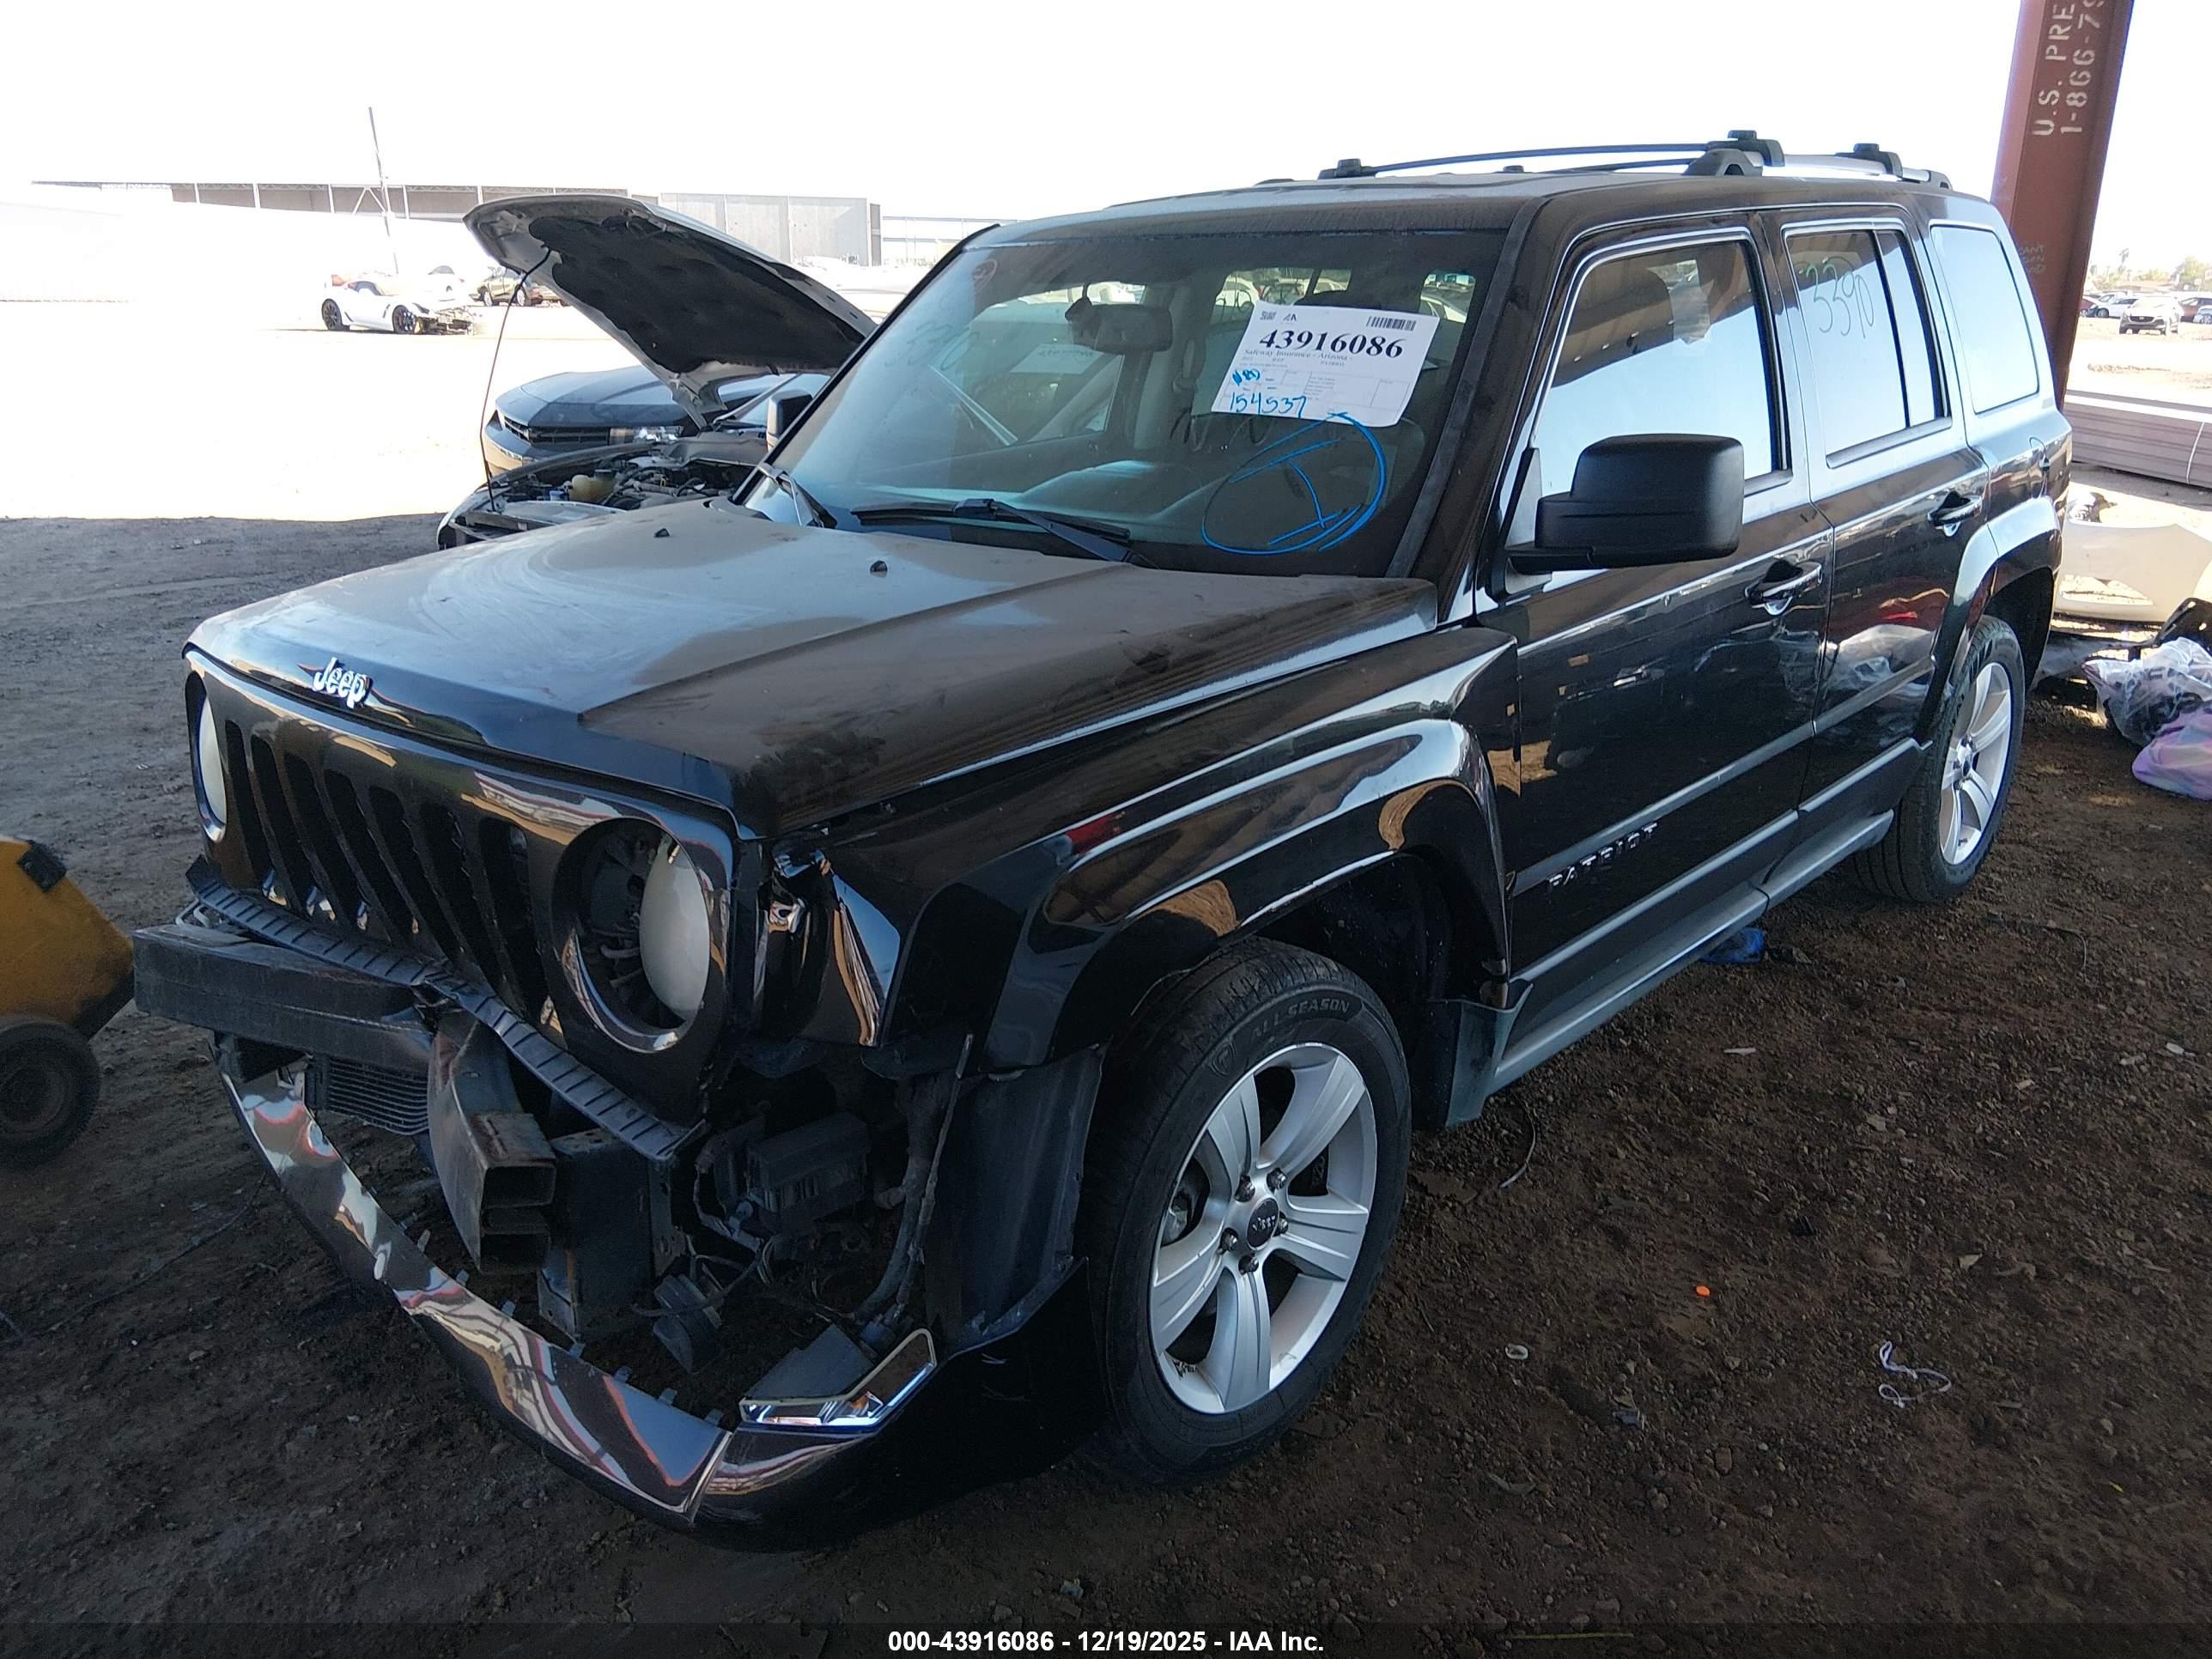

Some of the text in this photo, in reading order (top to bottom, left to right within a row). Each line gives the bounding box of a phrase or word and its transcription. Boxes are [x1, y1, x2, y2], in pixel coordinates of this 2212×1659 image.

[2032, 81, 2062, 136] U.S.
[1259, 329, 1407, 359] 43916086
[313, 656, 373, 709] Jeep
[1546, 822, 1658, 890] PATRIOT
[1287, 998, 1351, 1017] SEASON
